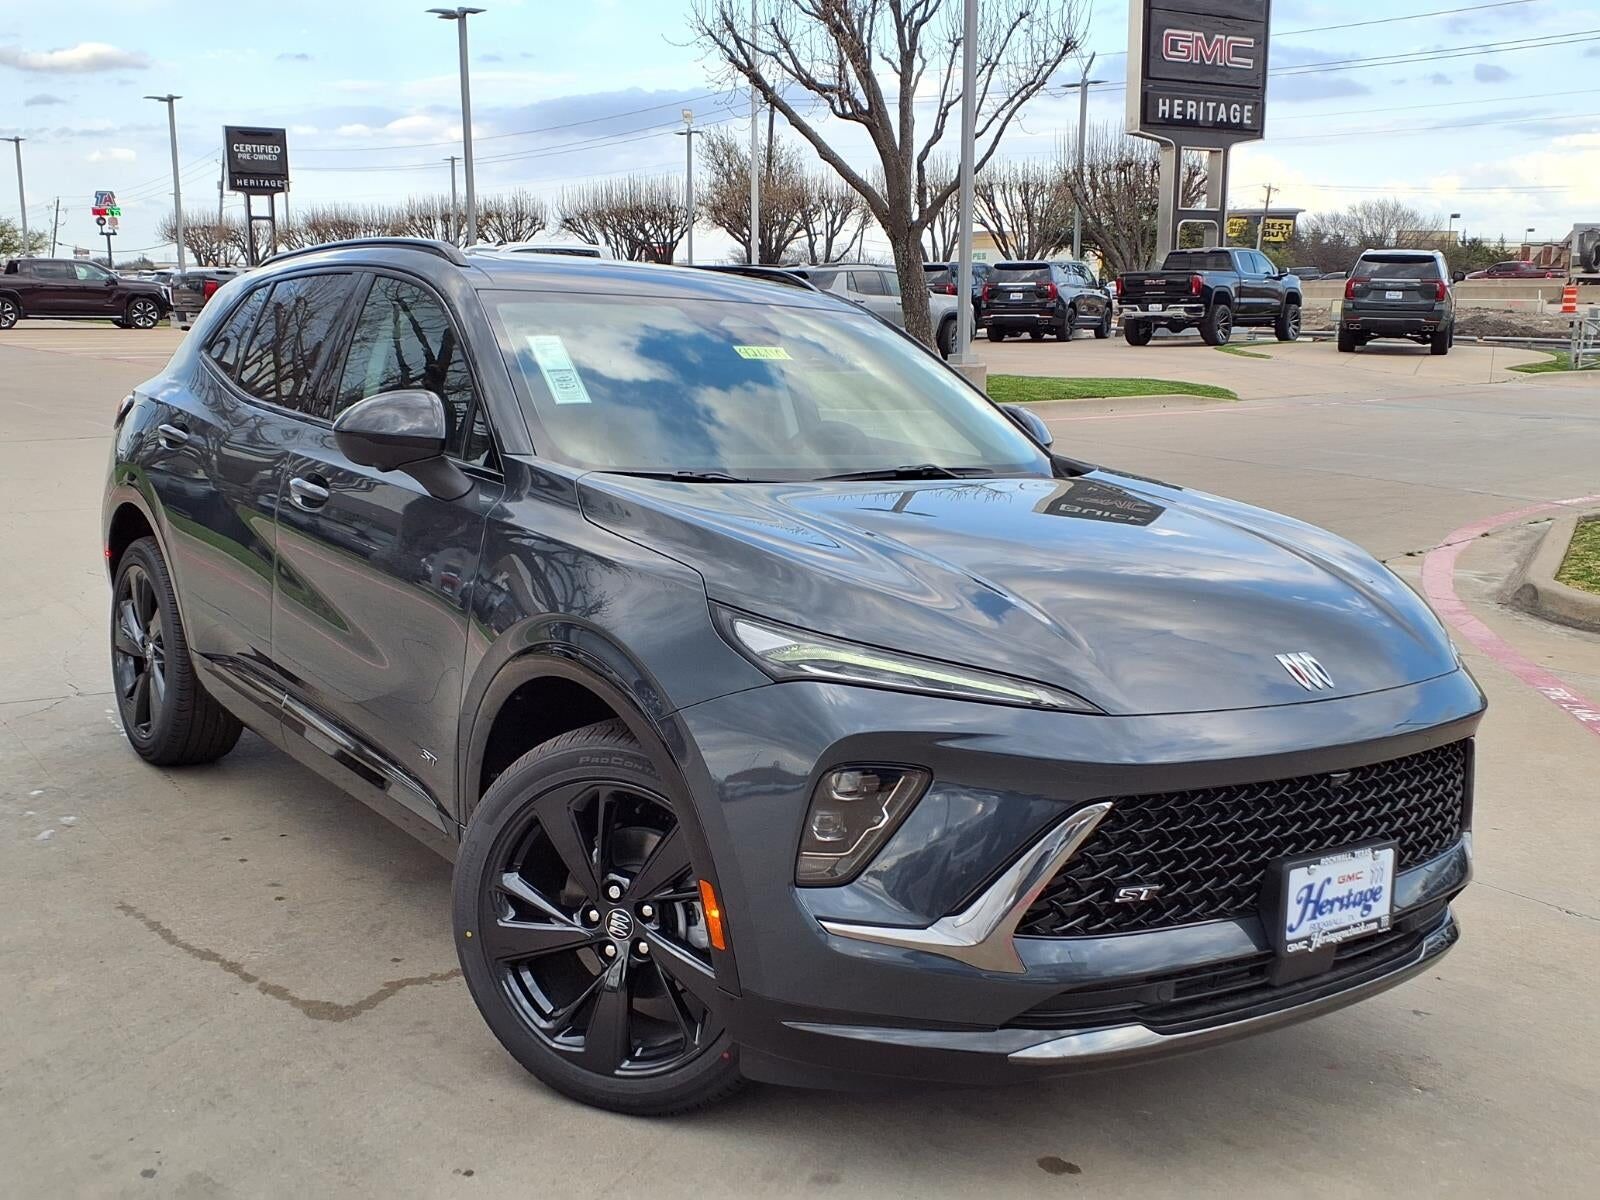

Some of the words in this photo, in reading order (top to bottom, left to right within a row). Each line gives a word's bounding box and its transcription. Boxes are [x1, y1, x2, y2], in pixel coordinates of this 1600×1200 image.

[1163, 28, 1255, 69] GMC
[1158, 98, 1253, 124] HERITAGE
[233, 143, 281, 154] CERTIFIED
[237, 152, 278, 161] PRE-OWNED
[236, 178, 284, 188] HERITAGE
[95, 190, 116, 206] TA
[1263, 222, 1292, 230] BEST
[1263, 230, 1290, 239] BUY
[1337, 870, 1364, 884] GMC
[1114, 885, 1160, 903] ST
[1287, 877, 1383, 933] Heritage
